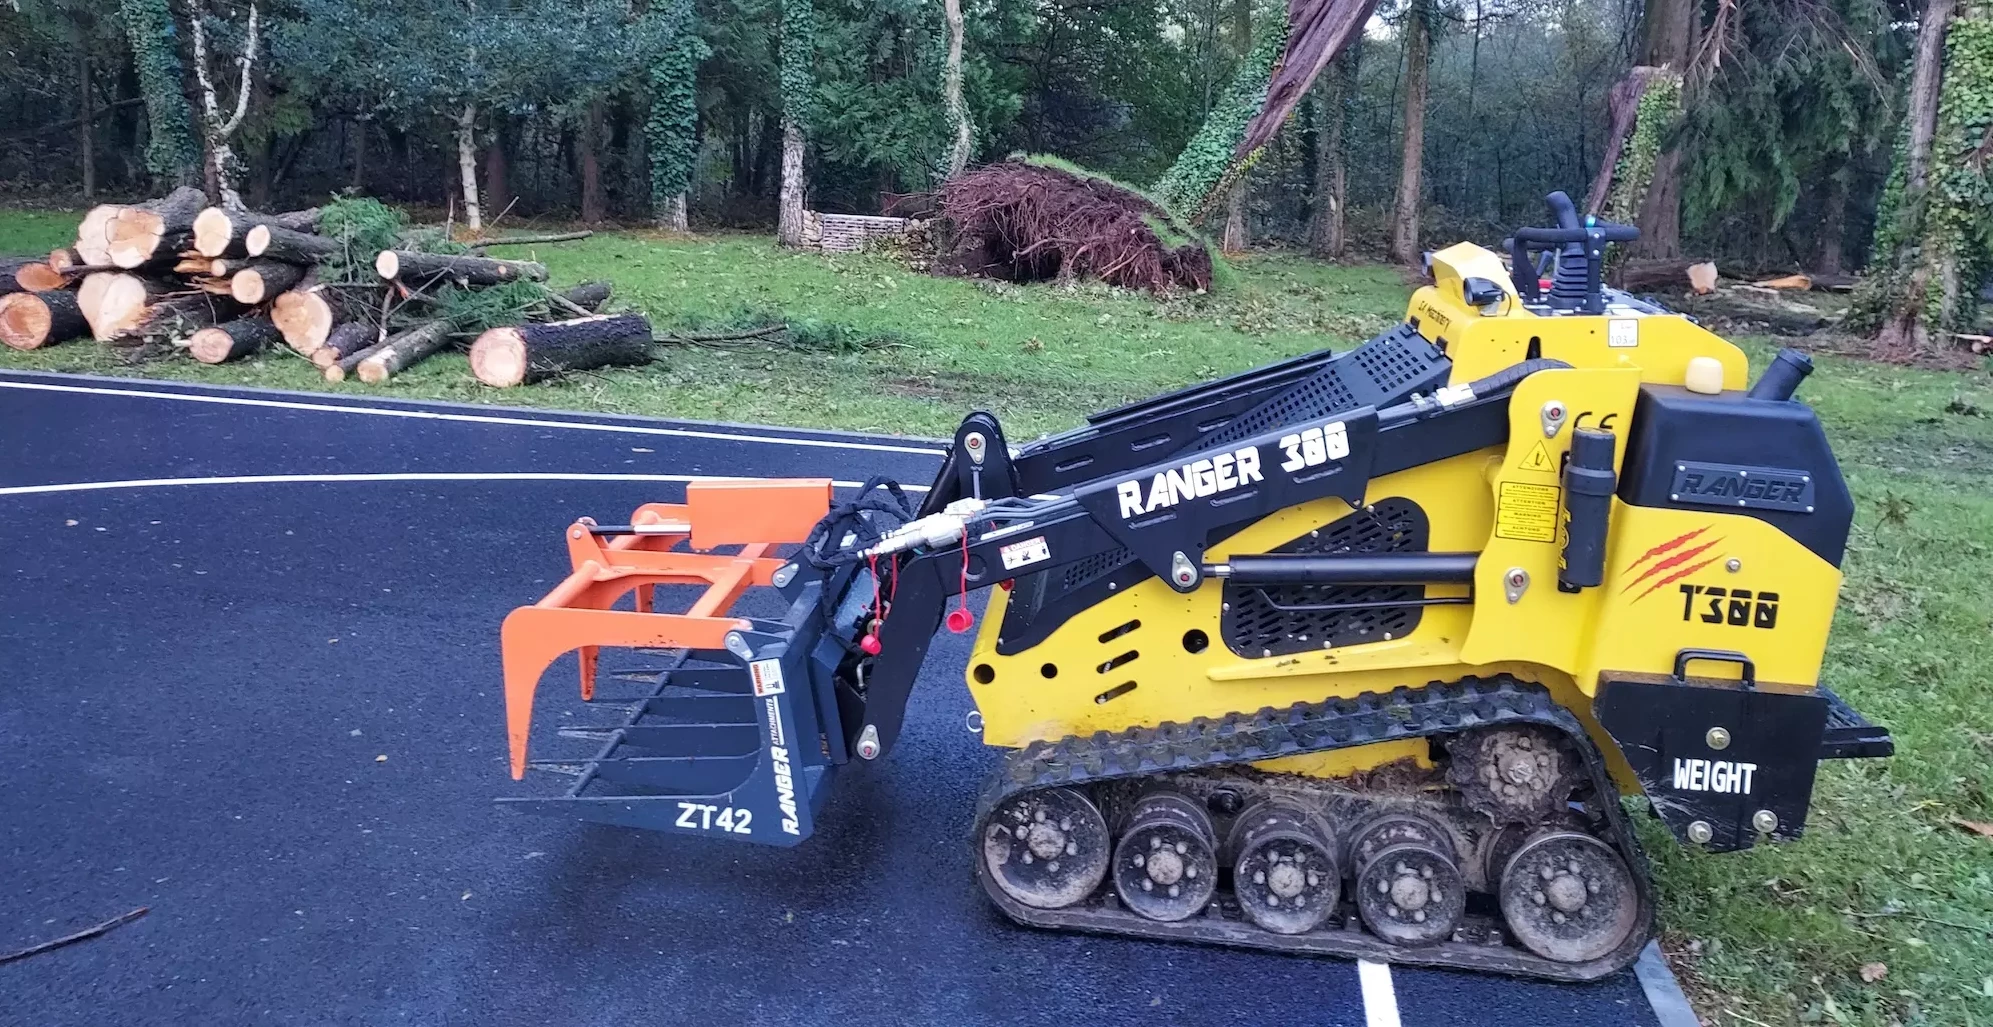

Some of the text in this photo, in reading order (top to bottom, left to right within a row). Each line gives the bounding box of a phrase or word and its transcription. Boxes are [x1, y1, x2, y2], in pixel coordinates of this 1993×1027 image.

[1116, 421, 1350, 519] RANGER 300
[1679, 473, 1806, 504] RANGER
[1680, 584, 1779, 629] T300
[752, 664, 763, 694] WARNING
[766, 698, 779, 745] ATTACHMENTS
[771, 745, 800, 835] RANGER
[1673, 757, 1758, 795] WEIGHT
[675, 802, 753, 834] ZT42
